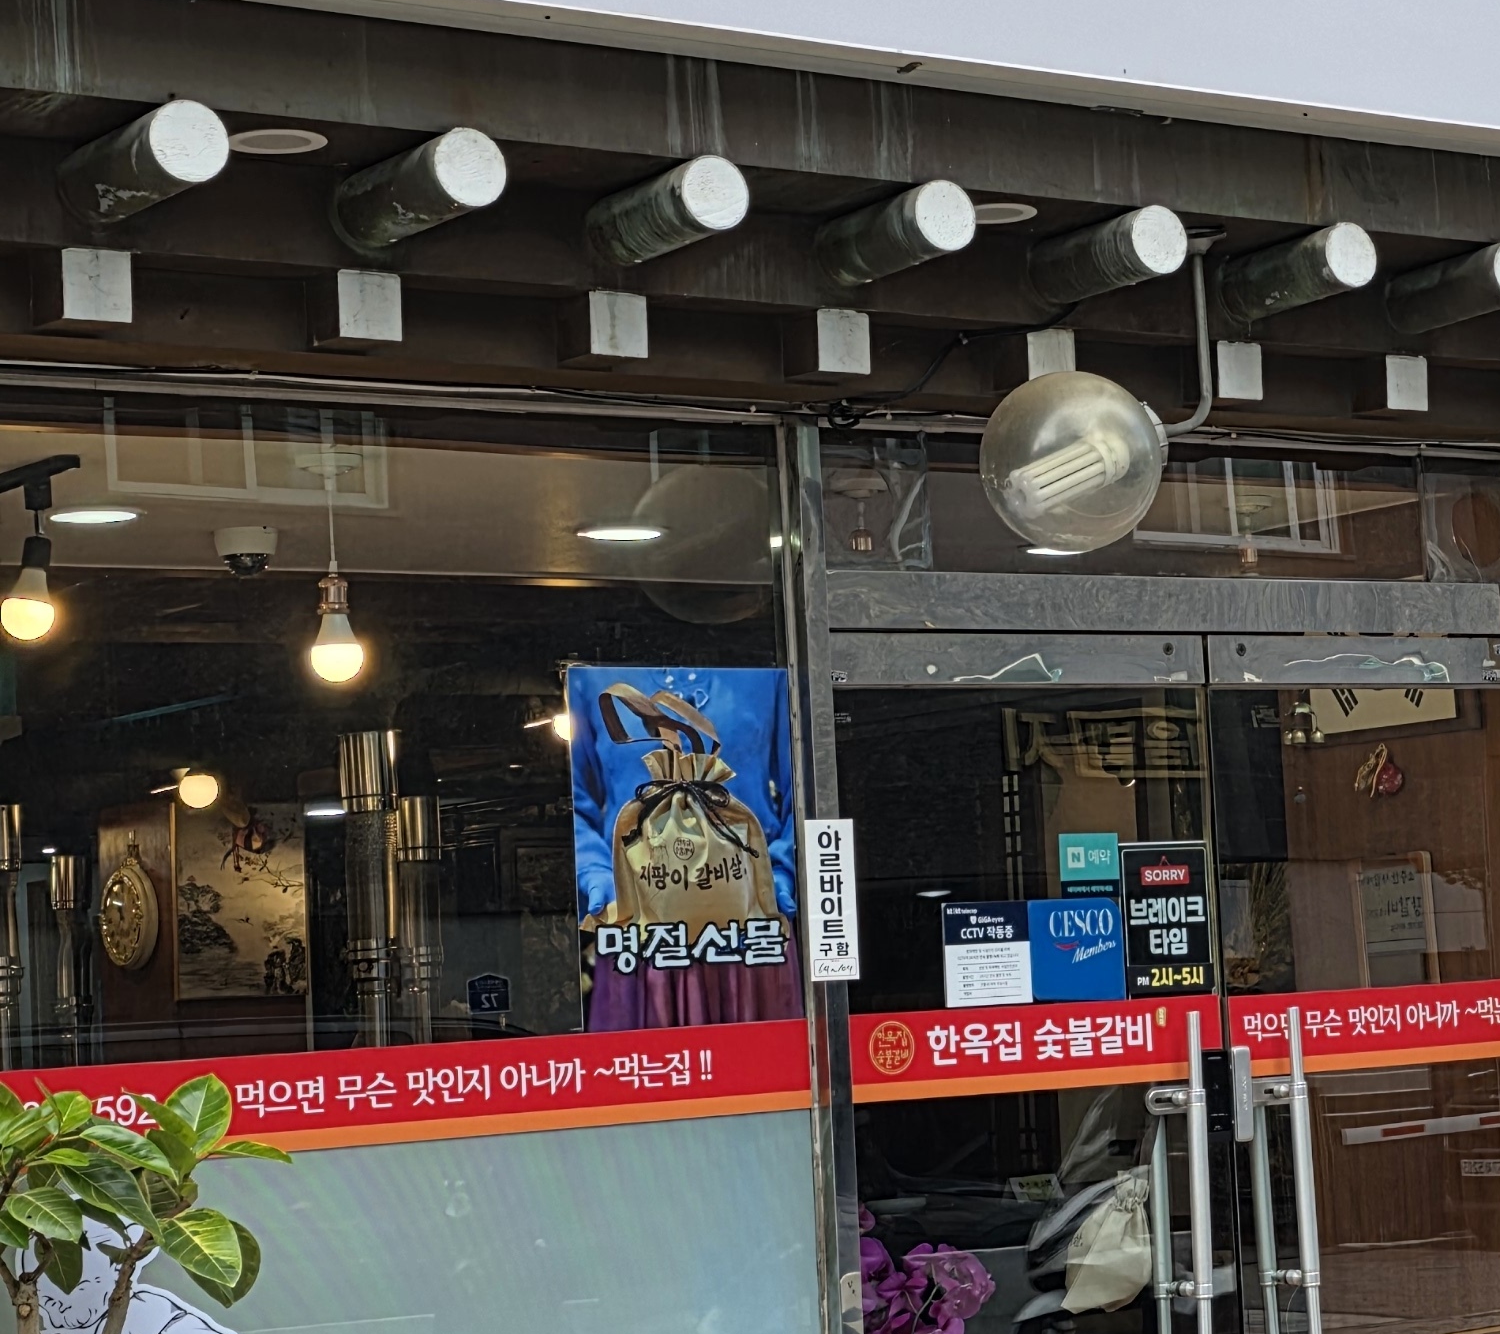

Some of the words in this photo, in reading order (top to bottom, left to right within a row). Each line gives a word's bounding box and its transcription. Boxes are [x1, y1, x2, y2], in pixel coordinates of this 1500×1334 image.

[1087, 848, 1111, 865] 예약
[817, 830, 845, 939] 아르바이트
[1144, 869, 1185, 882] SORRY
[1049, 908, 1114, 938] CESCO
[1130, 896, 1206, 926] 브레이크
[595, 919, 788, 974] 명절선물
[960, 927, 985, 939] CCTV
[986, 925, 1014, 940] 작동중
[1149, 927, 1188, 955] 타임
[819, 942, 850, 957] 구함
[1071, 938, 1117, 965] Members
[1137, 976, 1150, 986] PM
[1151, 966, 1204, 987] 2시~5시
[1304, 1014, 1343, 1038] 무슨
[1347, 1004, 1401, 1036] 맛인지
[1406, 999, 1461, 1031] 아니까
[926, 1020, 1023, 1067] 한옥집
[1033, 1012, 1154, 1061] 숯불갈비
[235, 1075, 325, 1119] 먹으면
[335, 1072, 398, 1111] 무슨
[406, 1063, 492, 1108] 맛인지
[499, 1057, 587, 1097] 아니까
